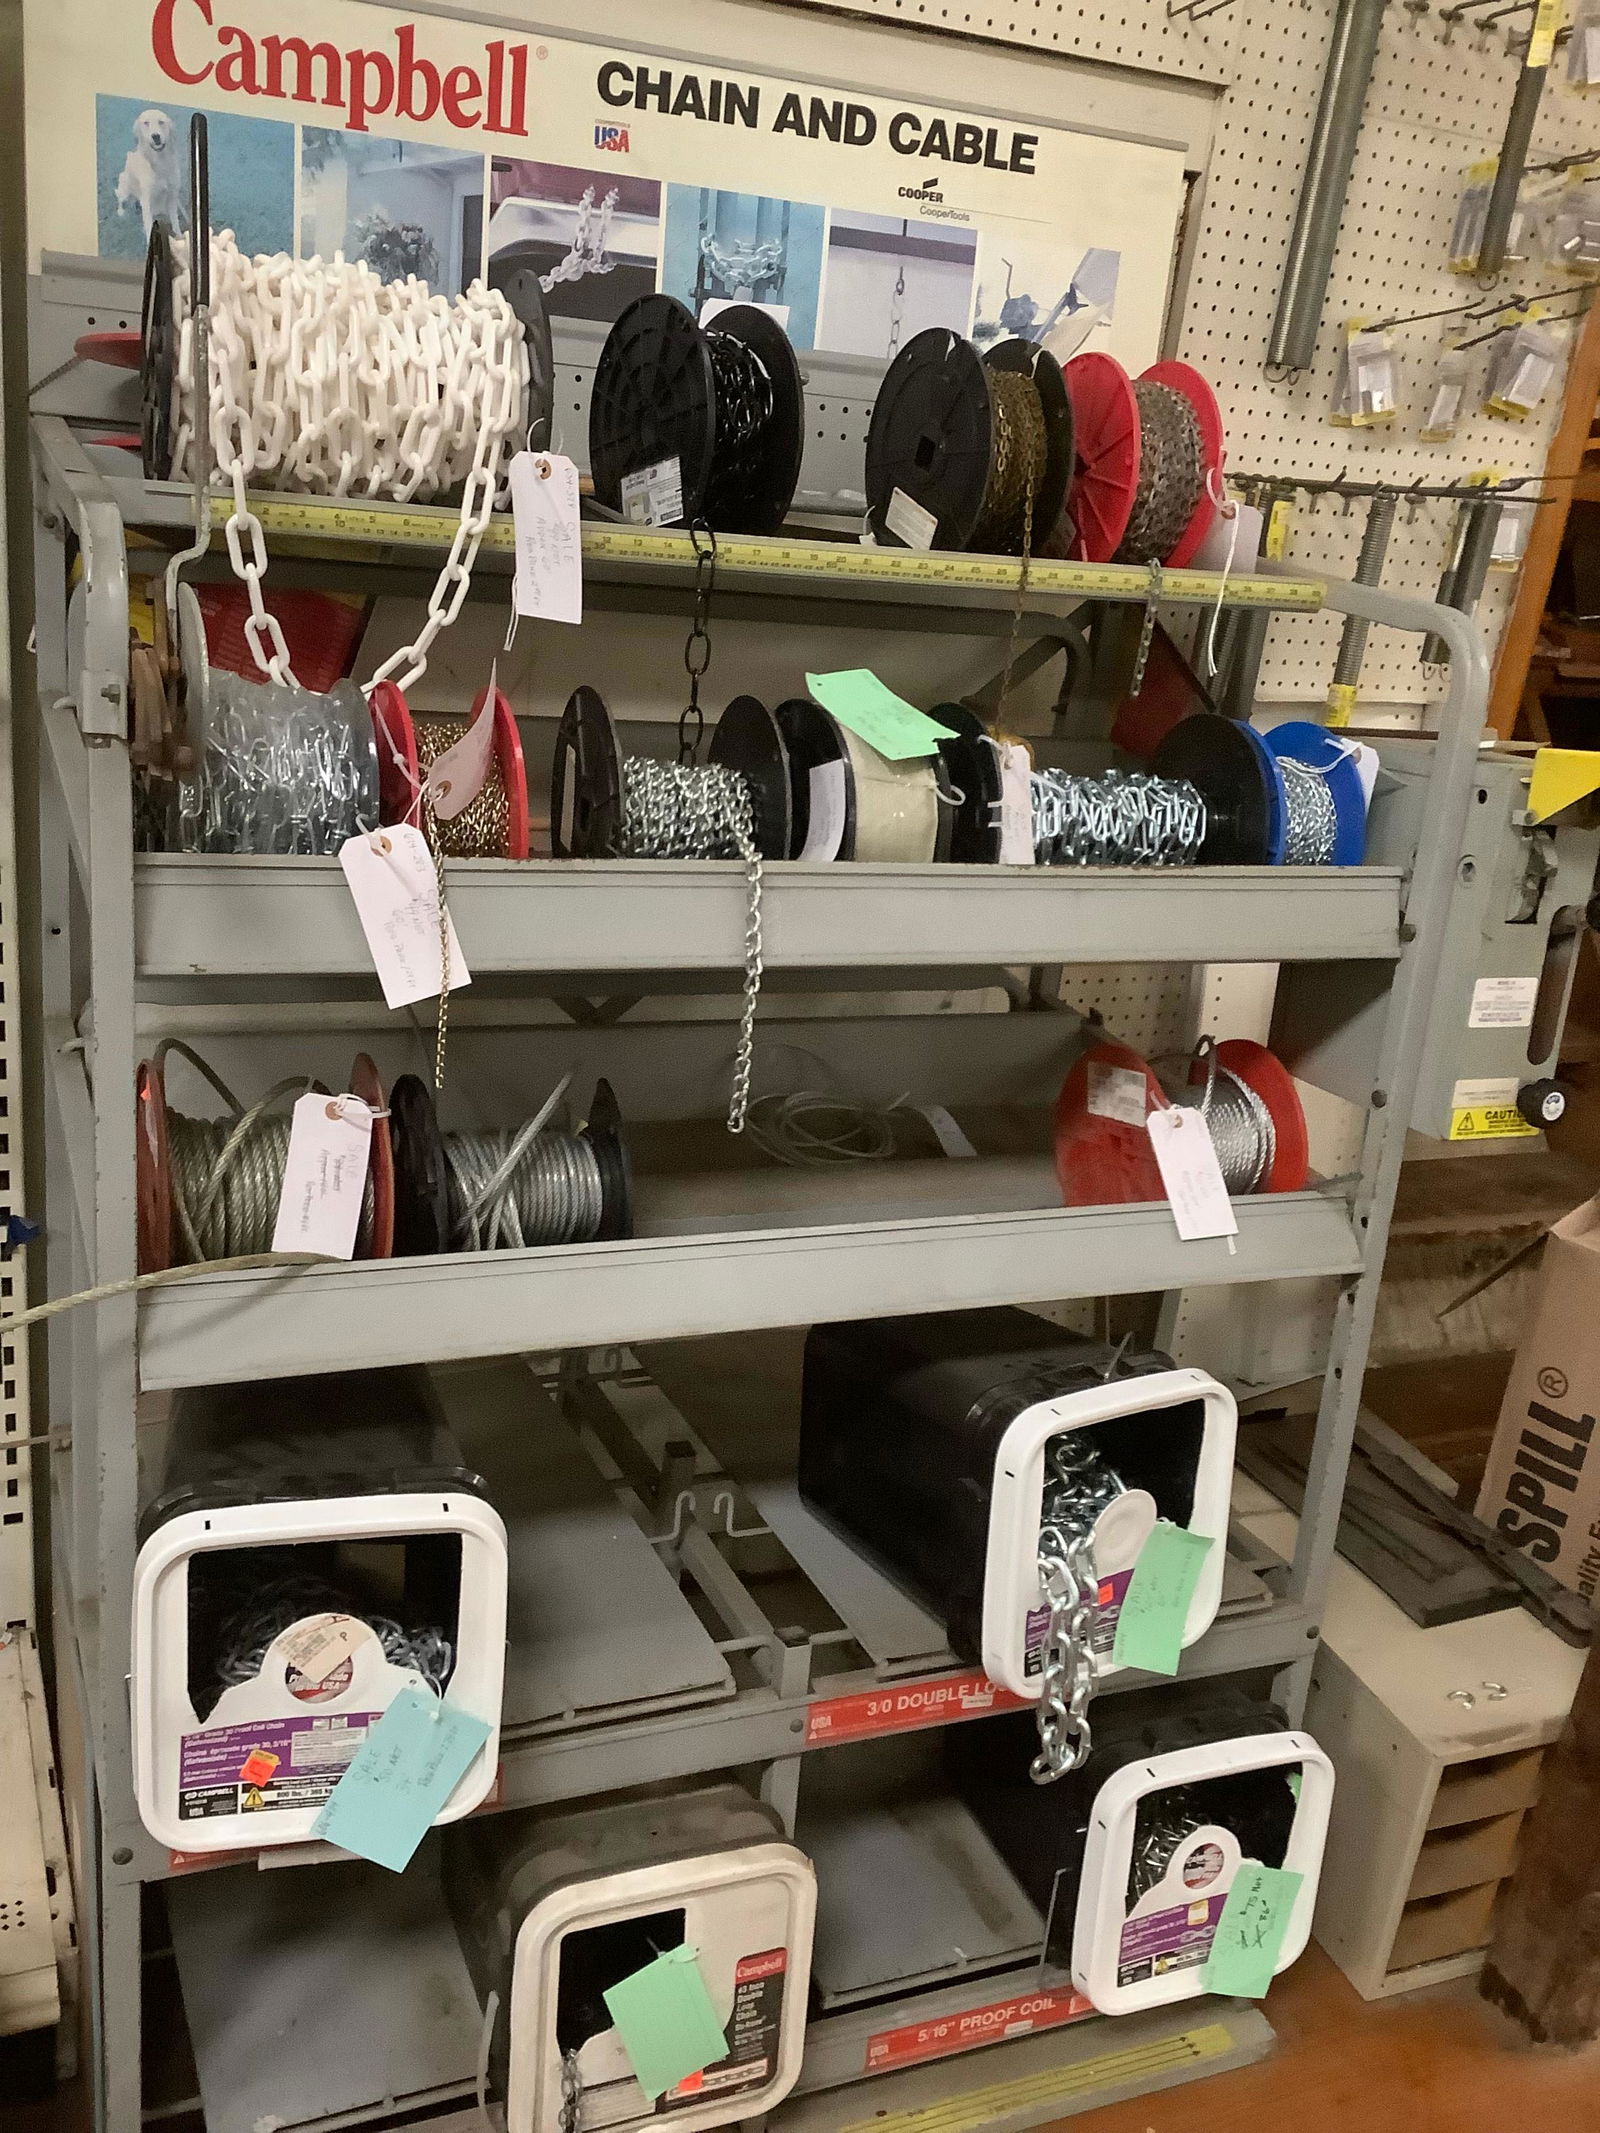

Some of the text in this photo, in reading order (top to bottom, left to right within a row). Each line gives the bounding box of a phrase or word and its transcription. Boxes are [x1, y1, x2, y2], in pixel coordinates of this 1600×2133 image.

[151, 0, 529, 137] Campbell
[596, 61, 1039, 175] CHAIN AND CABLE
[594, 125, 630, 153] USA
[898, 186, 944, 203] COOPER
[920, 205, 970, 221] CooperTools
[262, 507, 270, 515] 2
[299, 510, 305, 518] 3
[369, 516, 377, 524] 5
[335, 520, 346, 528] 10
[1497, 1401, 1596, 1562] SPILL
[867, 1699, 892, 1716] 3/0
[897, 1684, 970, 1710] DOUBLE
[266, 1722, 285, 1730] Chain
[198, 1788, 234, 1797] CAMPBELL
[737, 1957, 782, 1977] Campbell
[960, 2006, 1018, 2031] PROOF
[1020, 1998, 1056, 2016] COIL
